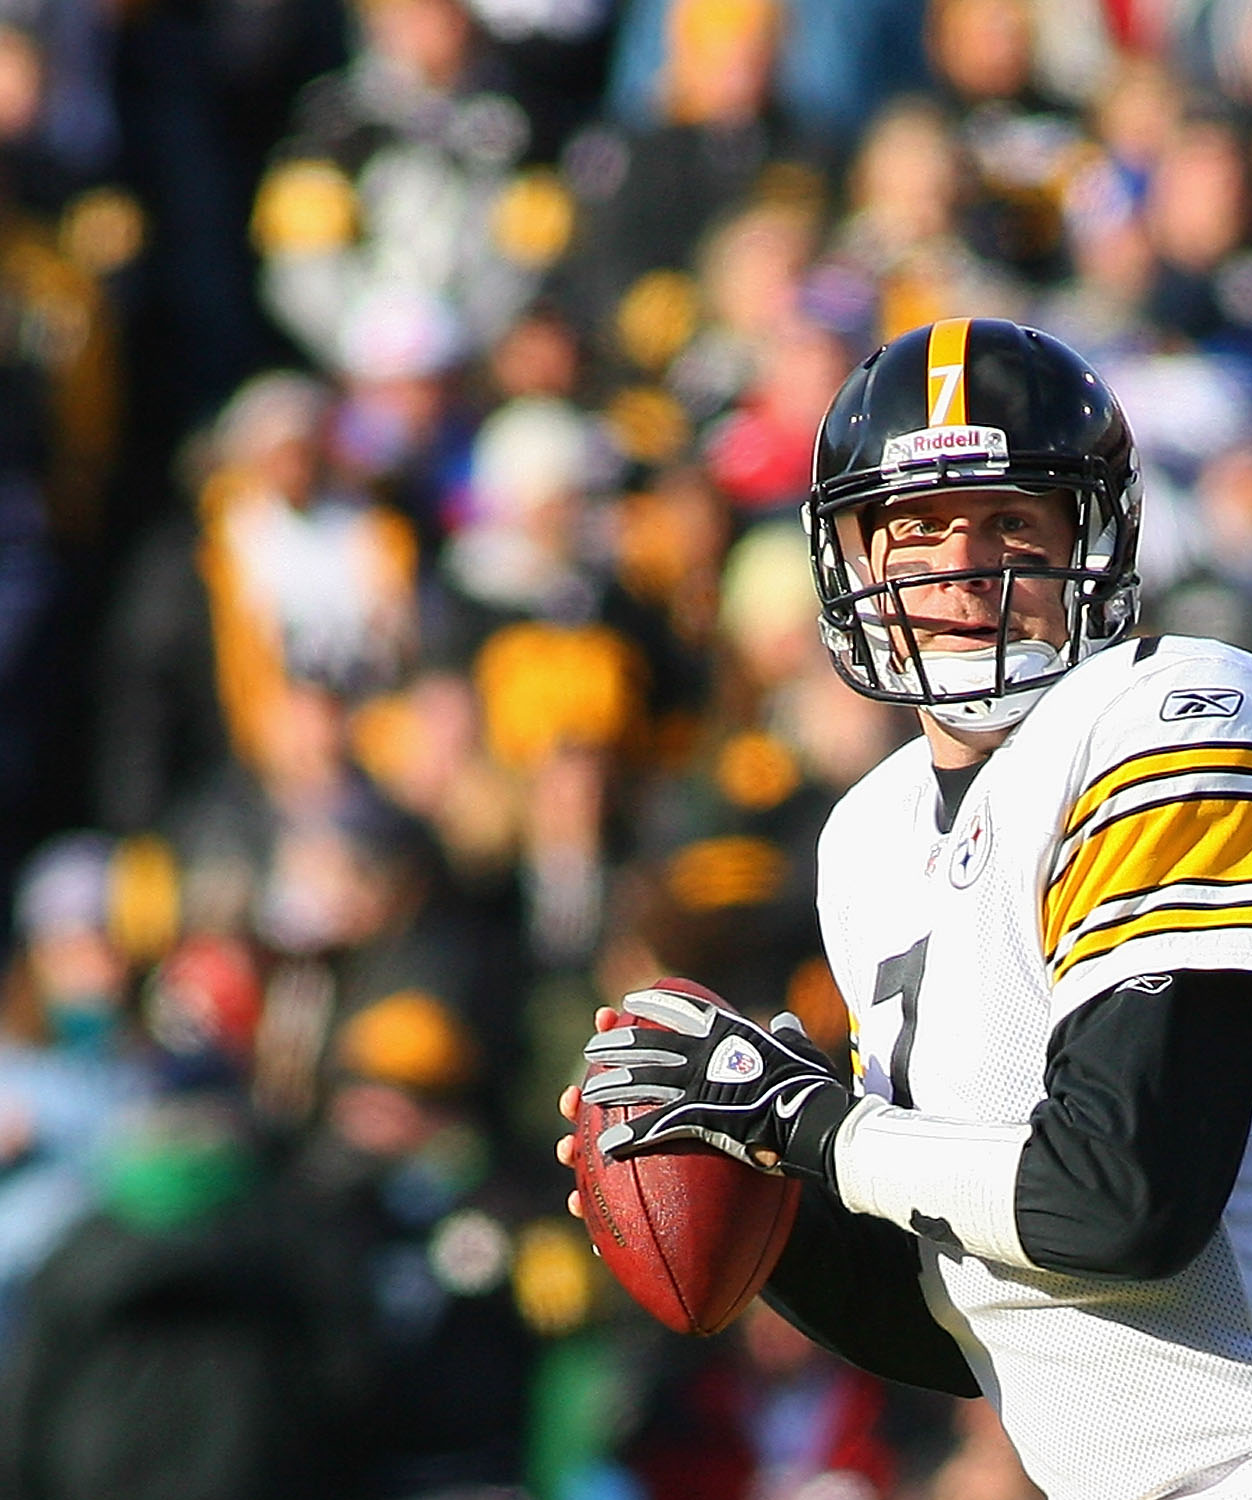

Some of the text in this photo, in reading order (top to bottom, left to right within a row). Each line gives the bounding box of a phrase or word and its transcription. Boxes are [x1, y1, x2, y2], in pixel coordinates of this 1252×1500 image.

[927, 363, 964, 428] 7
[913, 431, 981, 452] Riddell
[871, 930, 932, 1110] 7
